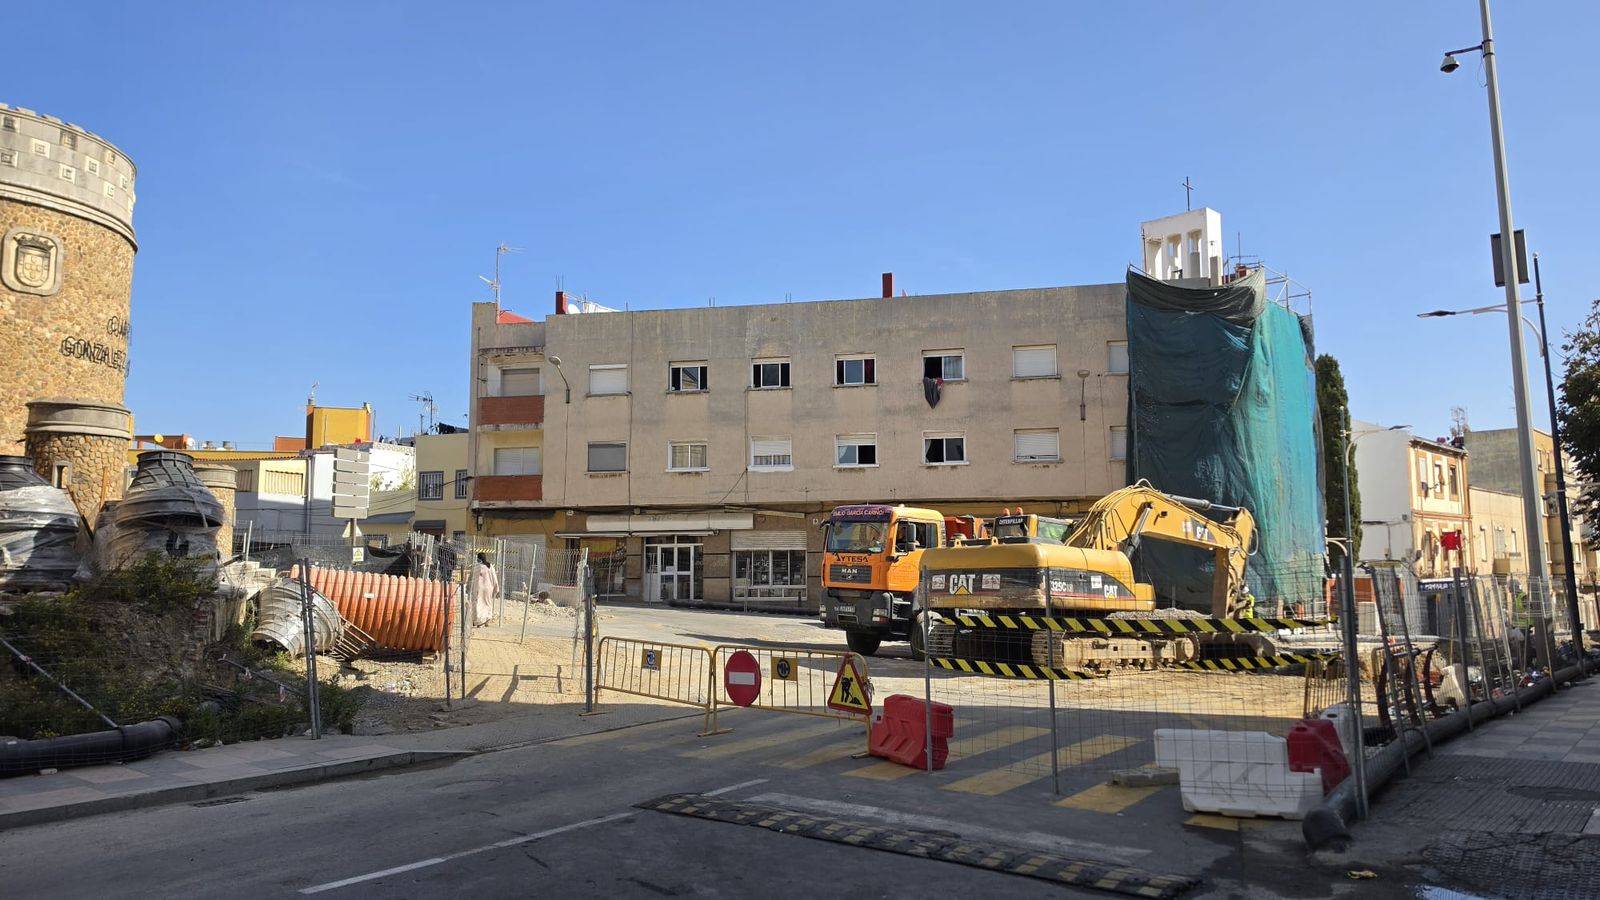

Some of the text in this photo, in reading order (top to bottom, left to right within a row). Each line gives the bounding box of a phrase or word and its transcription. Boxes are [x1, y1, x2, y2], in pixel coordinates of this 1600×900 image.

[60, 335, 127, 371] GONZALEZ
[835, 552, 869, 563] AYTESA
[949, 573, 976, 595] CAT
[1103, 584, 1118, 598] CAT
